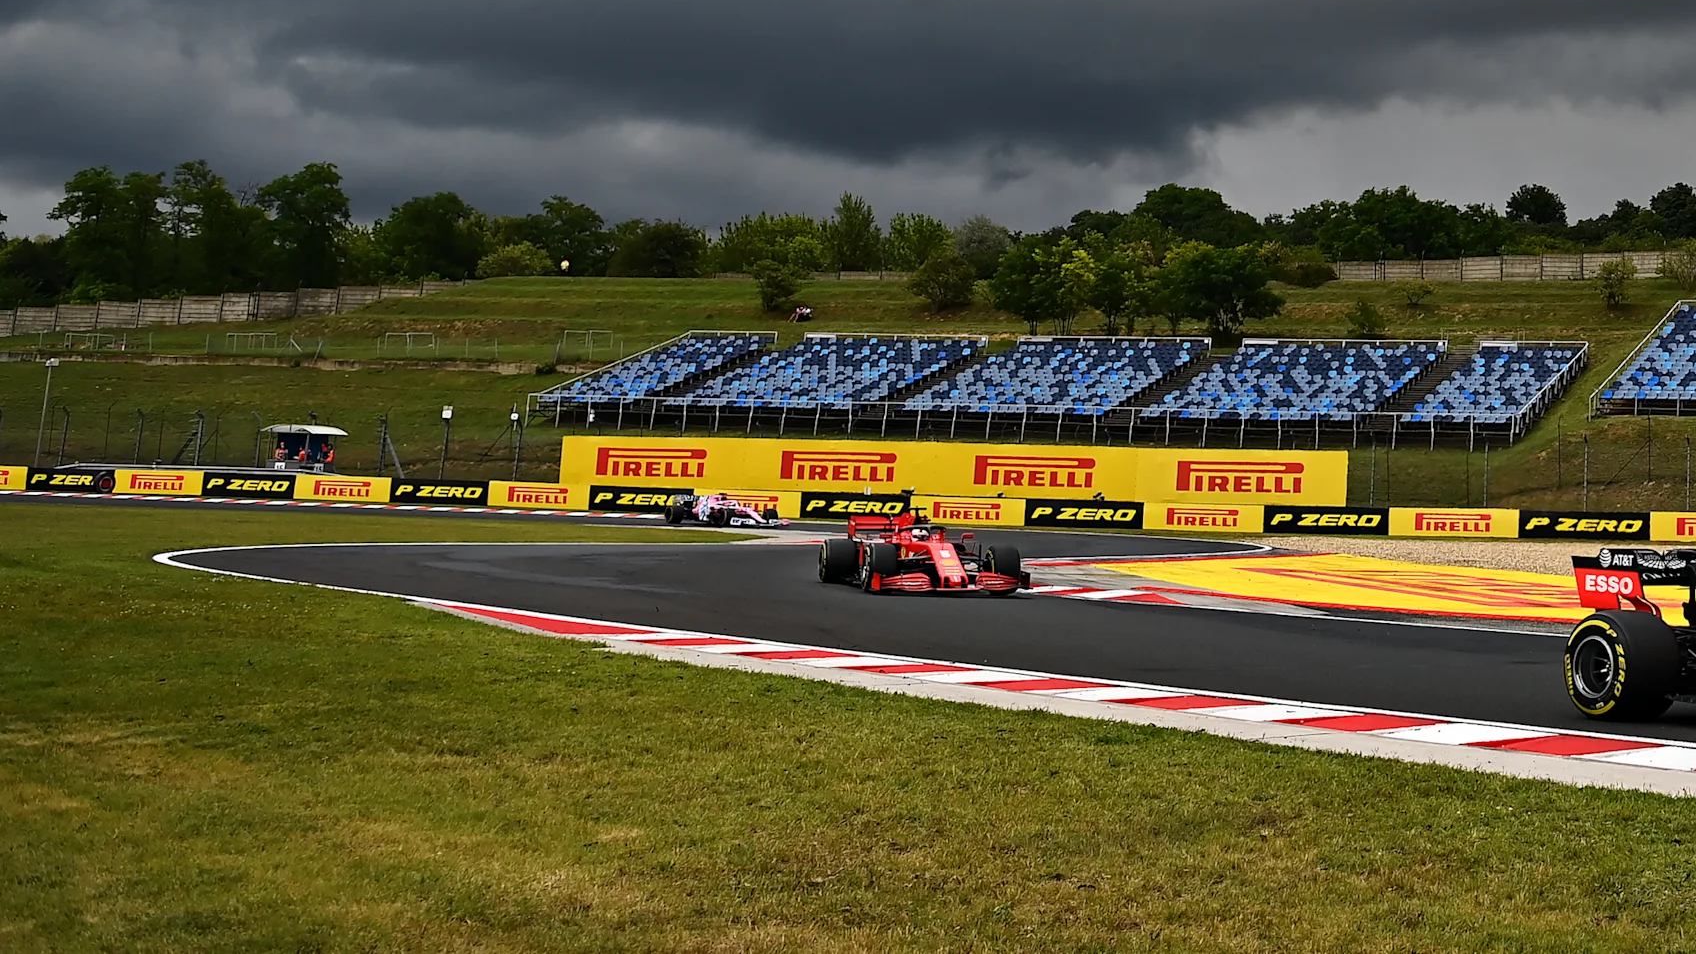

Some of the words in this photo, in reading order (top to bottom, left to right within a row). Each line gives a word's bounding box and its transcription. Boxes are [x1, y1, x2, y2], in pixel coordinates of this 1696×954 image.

[596, 447, 707, 477] PIRELLI
[780, 451, 897, 482] PIRELLI
[31, 474, 47, 484] P
[49, 474, 94, 486] ZER
[974, 455, 1096, 488] PIRELLI
[1176, 461, 1304, 493] PIRELLI
[130, 474, 185, 491] PIRELLI
[207, 478, 224, 489] P
[228, 479, 290, 492] ZERO
[313, 480, 371, 497] PIRELLI
[395, 485, 413, 496] P
[418, 486, 483, 499] ZERO
[508, 486, 569, 504] PIRELLI
[594, 493, 613, 504] P
[806, 500, 827, 512] P
[829, 501, 904, 514] ZERO
[933, 501, 1001, 520] PIRELLI
[1031, 507, 1053, 519] P
[1056, 507, 1136, 521] ZERO
[1166, 508, 1239, 527] PIRELLI
[1270, 513, 1293, 526] P
[1297, 514, 1380, 527] ZERO
[1415, 513, 1492, 532] PIRELLI
[1525, 517, 1549, 530] P
[1554, 518, 1643, 533] ZERO
[1612, 554, 1634, 567] AT&T
[1585, 574, 1633, 595] ESSO
[1614, 643, 1626, 698] ZERO
